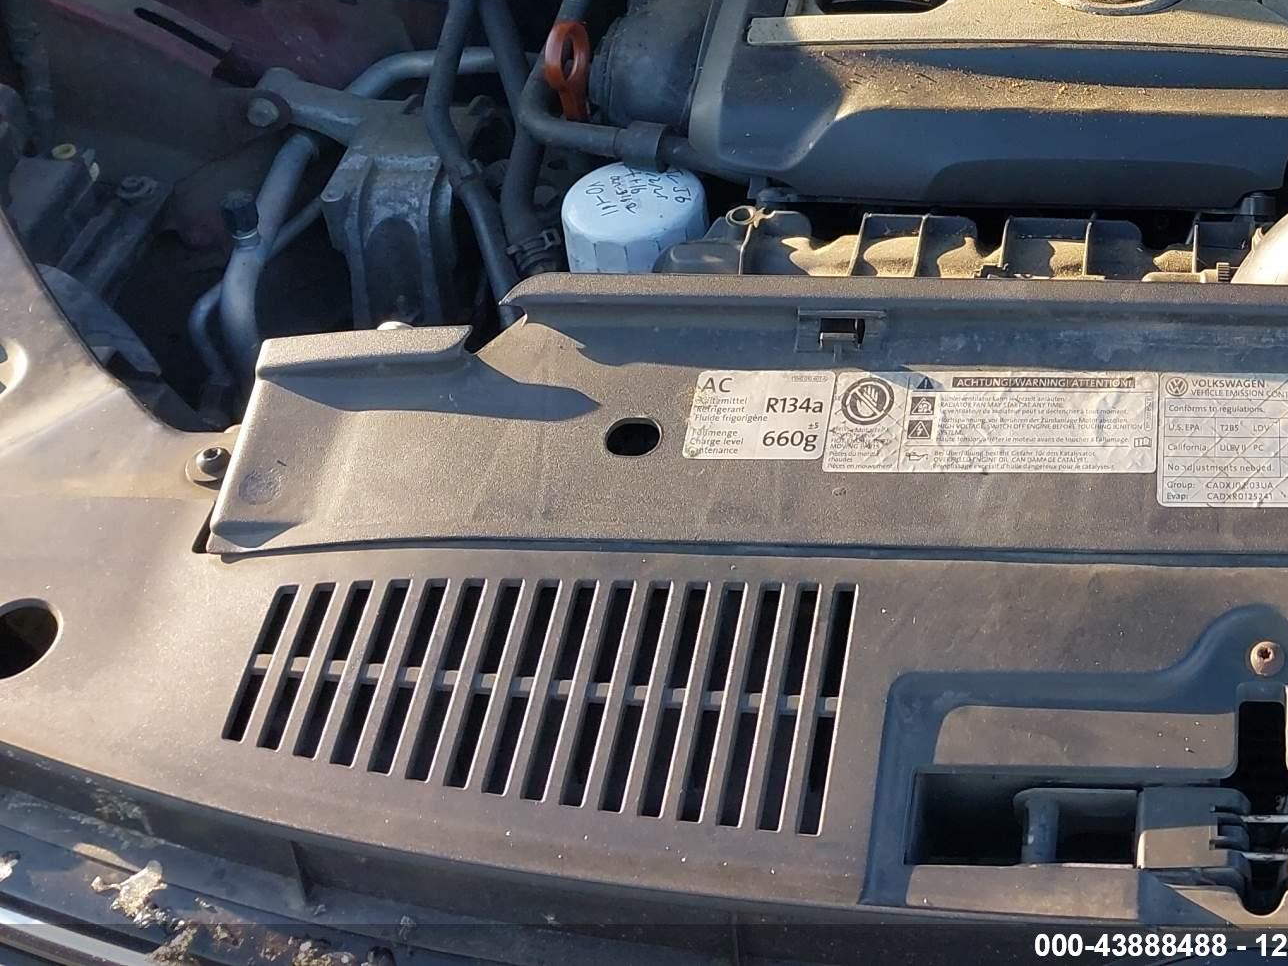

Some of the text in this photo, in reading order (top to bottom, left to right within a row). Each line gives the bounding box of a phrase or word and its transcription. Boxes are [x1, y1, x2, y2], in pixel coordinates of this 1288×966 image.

[700, 377, 733, 393] AC
[957, 378, 1133, 388] ACHTUNG! WARNING! ATTENTION!
[1191, 379, 1265, 388] VOLKSWAGEN
[696, 405, 745, 414] Refrigerant
[766, 397, 823, 413] R134a
[1168, 404, 1207, 413] Conforms
[1209, 405, 1218, 413] to
[722, 414, 768, 423] frigorigène
[1168, 422, 1200, 431] U.S. EPA
[1220, 424, 1239, 432] T2B5
[690, 437, 720, 446] Charge
[762, 430, 818, 452] 660g
[1182, 464, 1237, 473] adjustments
